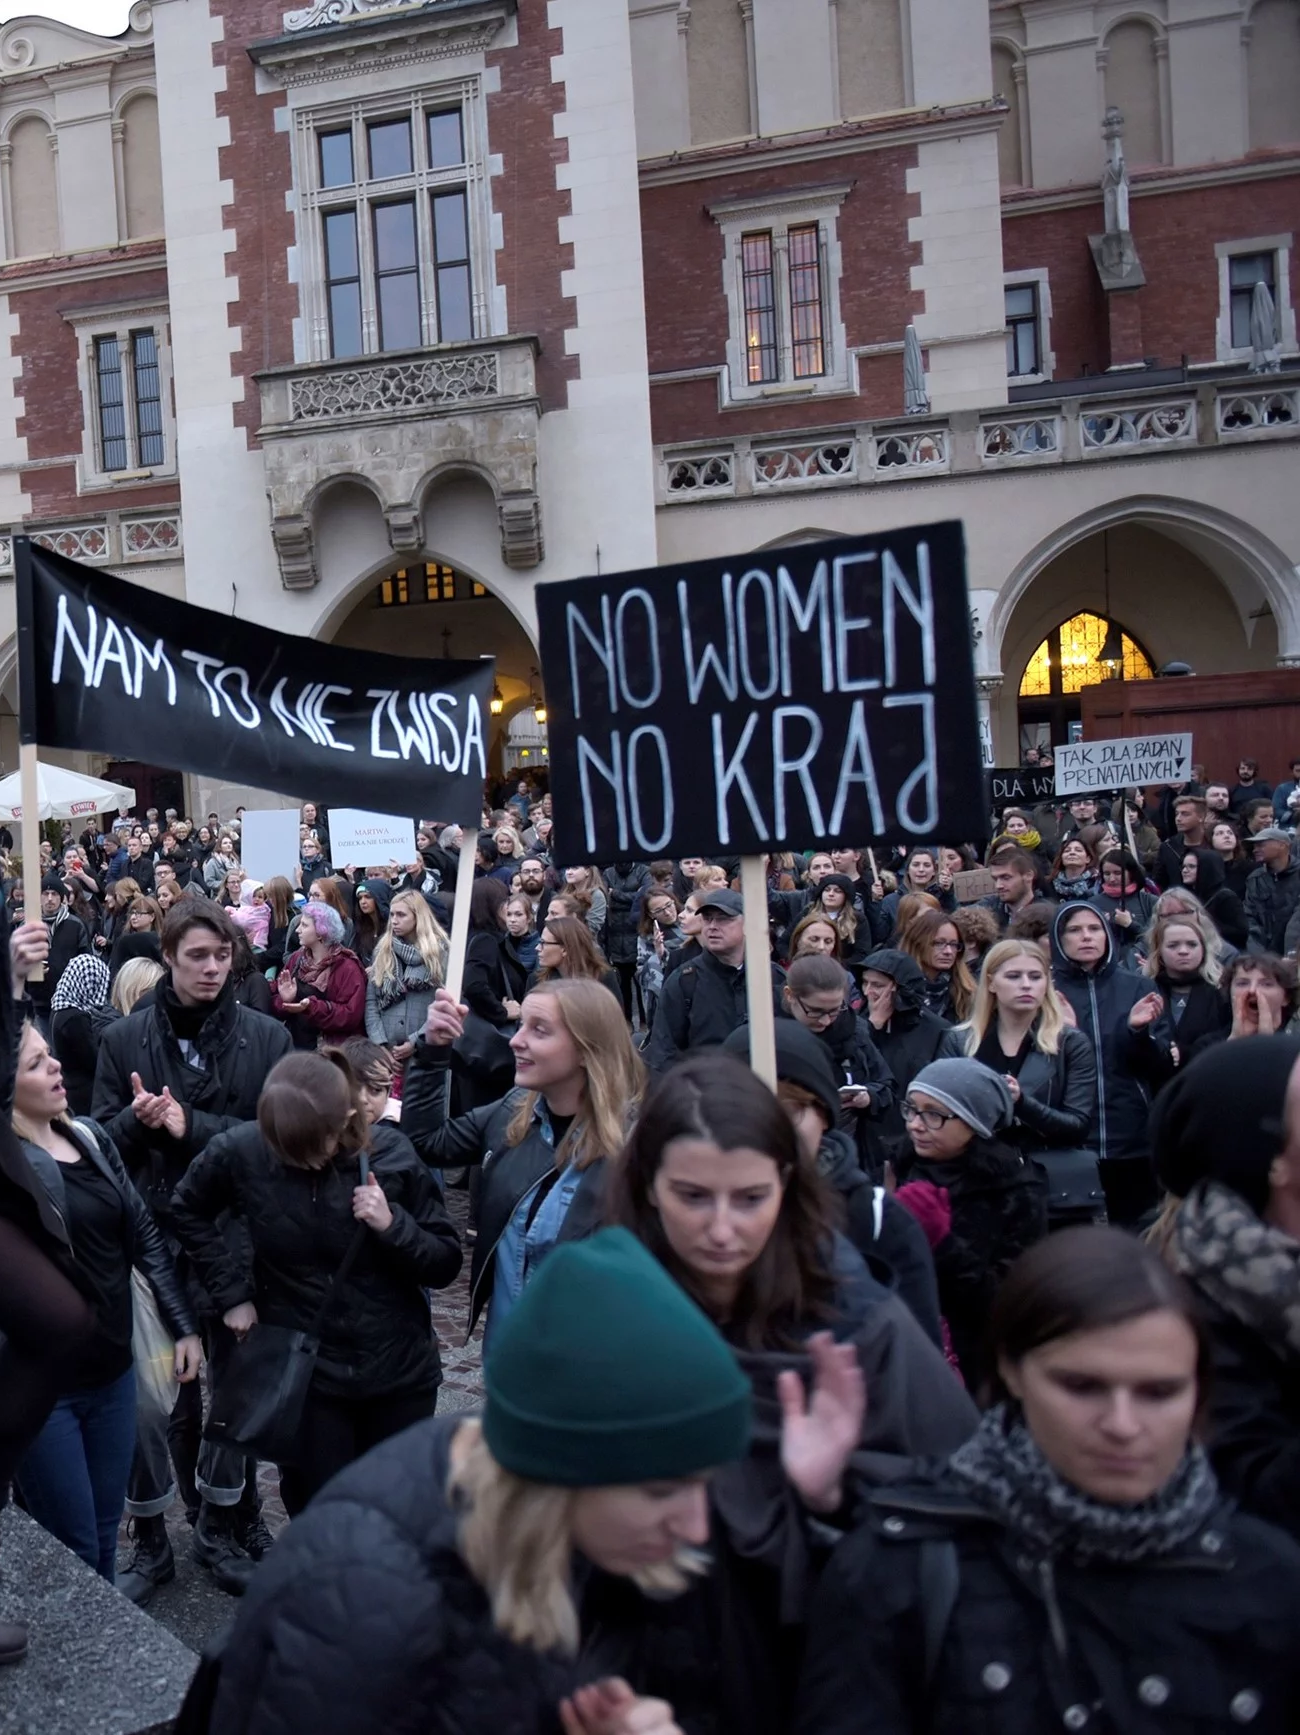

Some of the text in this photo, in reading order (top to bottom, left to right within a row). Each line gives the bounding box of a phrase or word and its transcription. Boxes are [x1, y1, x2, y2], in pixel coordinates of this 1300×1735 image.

[566, 540, 936, 719] NO WOMEN
[52, 594, 487, 779] NAM TO NIE ZWISA
[1059, 748, 1094, 768] TAK
[1100, 745, 1131, 764] DLA
[576, 691, 939, 854] NO KRAJ
[1063, 757, 1187, 788] PRENATALNYCH!
[993, 779, 1025, 798] DLA
[337, 840, 366, 848] DZIECKA
[354, 828, 390, 837] MARTWA
